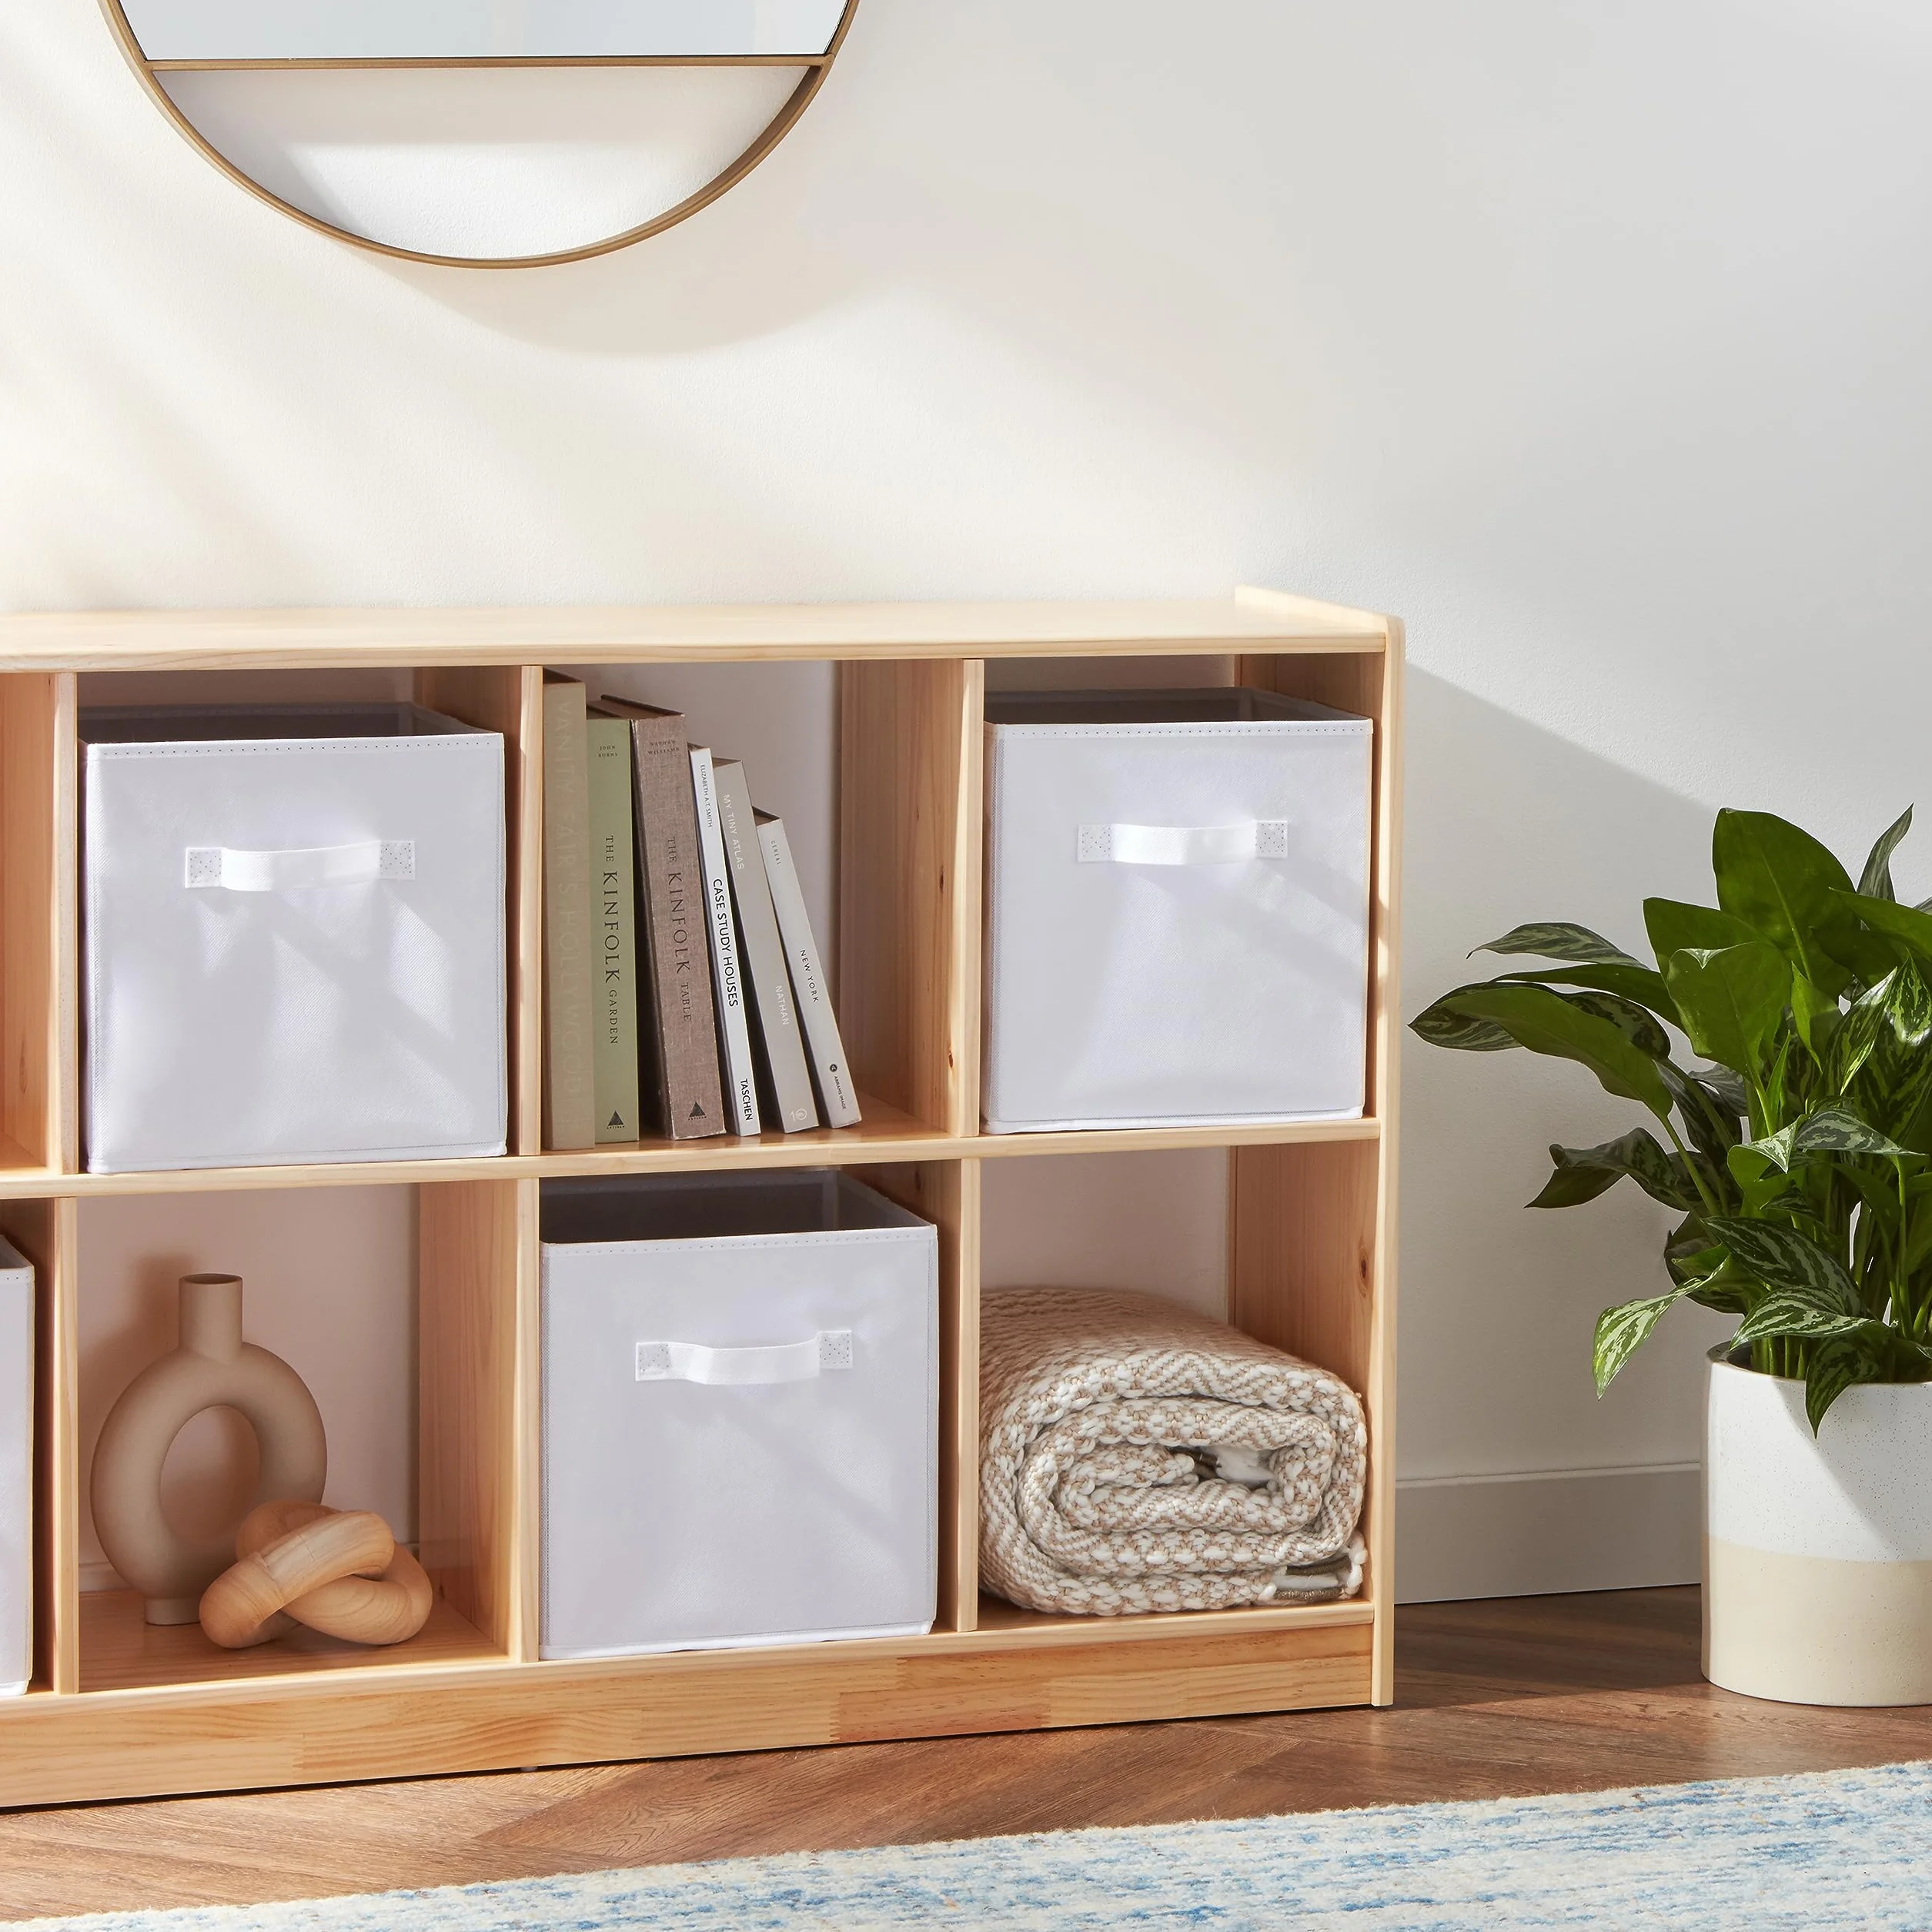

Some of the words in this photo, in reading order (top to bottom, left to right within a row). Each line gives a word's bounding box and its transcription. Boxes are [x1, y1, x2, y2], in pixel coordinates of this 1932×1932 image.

[647, 747, 680, 755] WILLIAMS
[700, 764, 709, 796] ELIZABETH
[724, 794, 732, 809] MY
[727, 813, 737, 835] TINY
[605, 835, 614, 862] THE
[667, 836, 677, 862] THE
[732, 839, 744, 870] ATLAS
[770, 840, 781, 865] CEREAL
[713, 878, 726, 910] CASE
[603, 871, 620, 984] KINFOLK
[668, 871, 690, 974] KINFOLK
[717, 912, 732, 952] STUDY
[724, 956, 738, 1007] HOUSES
[800, 949, 811, 971] NEW
[807, 976, 819, 1003] YORK
[609, 989, 618, 1044] GARDEN
[680, 982, 692, 1021] TABLE
[775, 985, 789, 1025] NATHAN
[740, 1078, 753, 1121] TASCHEN
